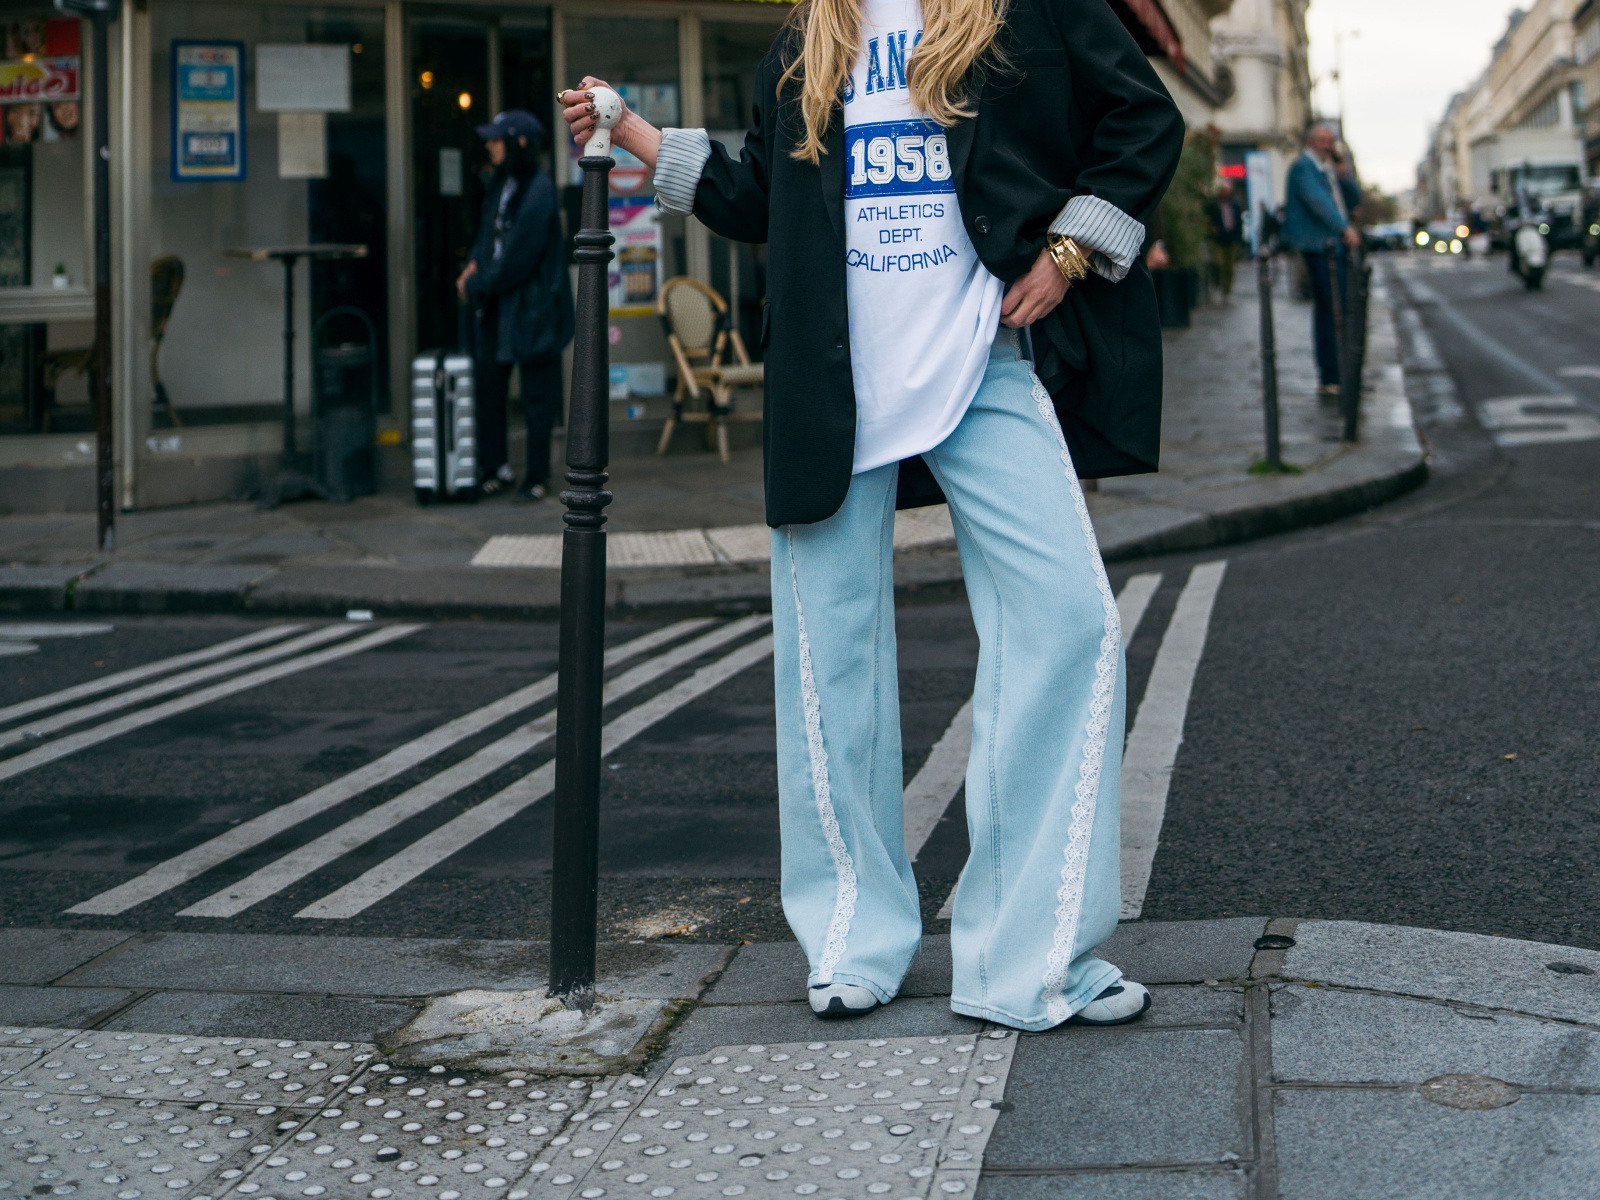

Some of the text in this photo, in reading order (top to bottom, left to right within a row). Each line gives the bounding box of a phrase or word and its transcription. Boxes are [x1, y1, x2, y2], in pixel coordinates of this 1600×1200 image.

[851, 134, 952, 186] 1958
[857, 203, 945, 222] ATHLETICS
[879, 228, 922, 244] DEPT.
[845, 244, 958, 272] CALIFORNIA
